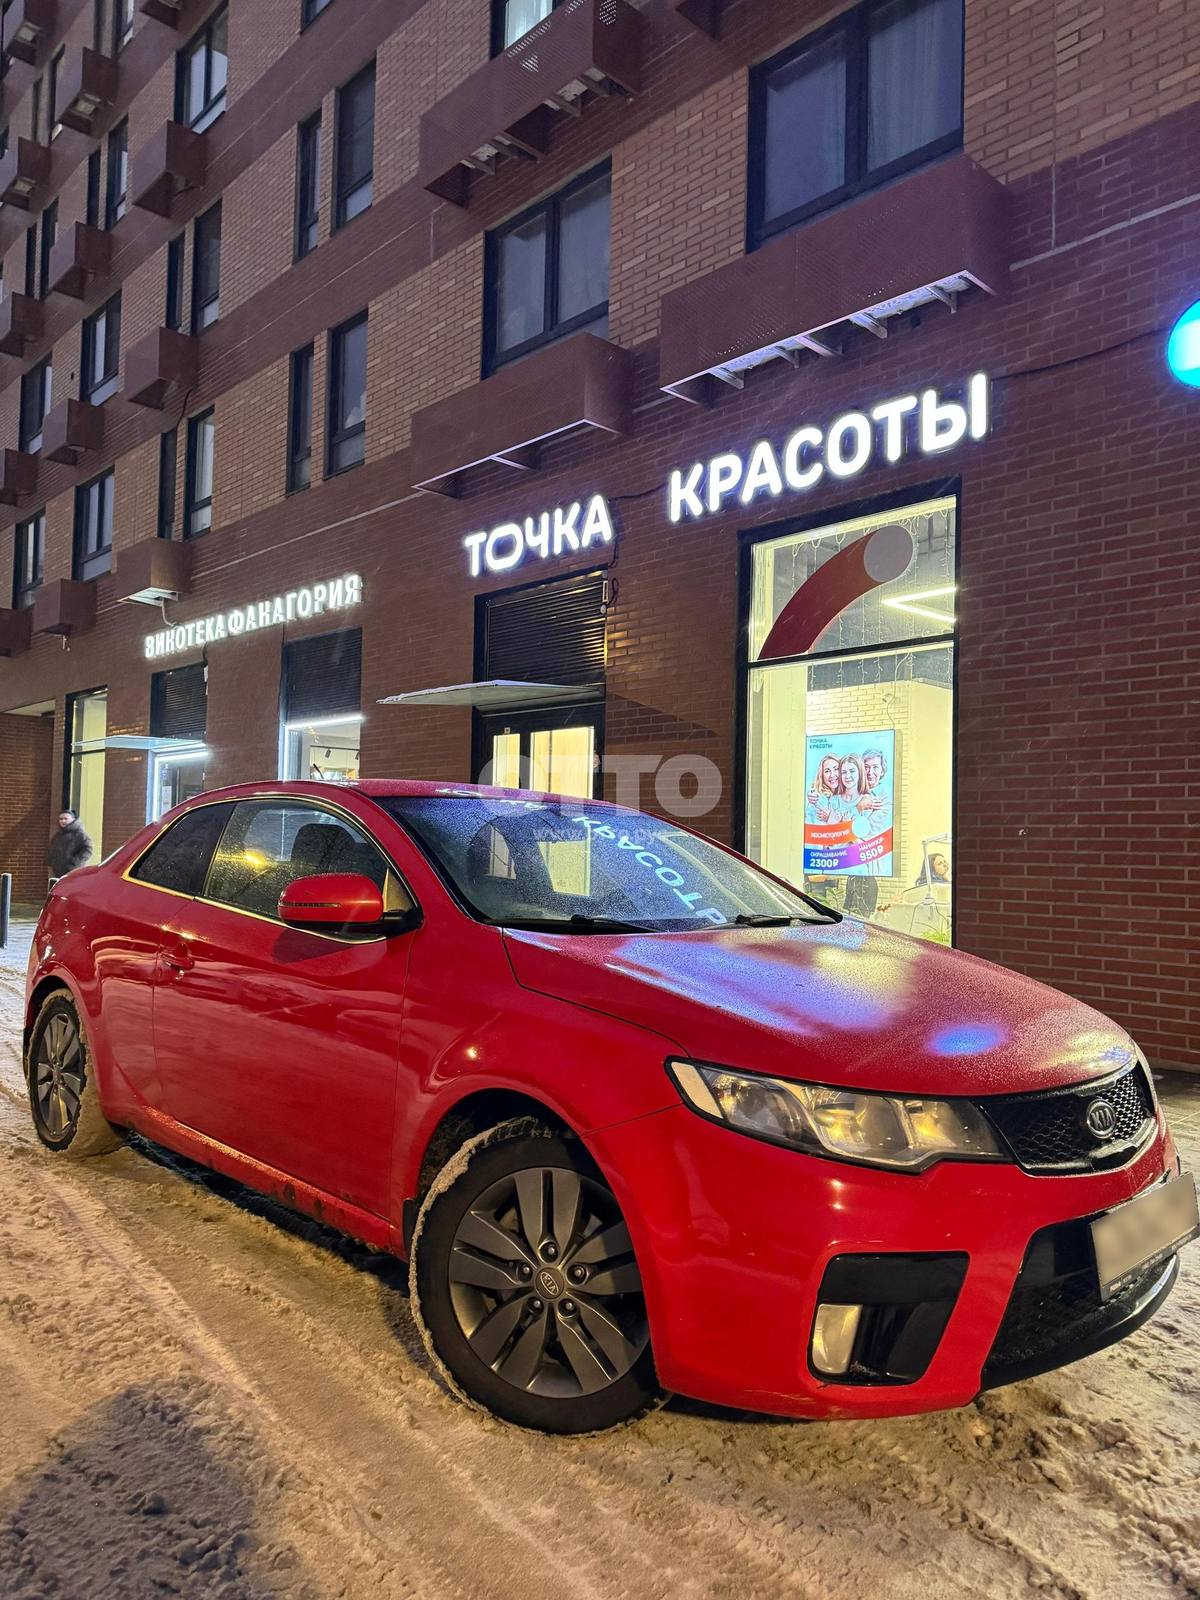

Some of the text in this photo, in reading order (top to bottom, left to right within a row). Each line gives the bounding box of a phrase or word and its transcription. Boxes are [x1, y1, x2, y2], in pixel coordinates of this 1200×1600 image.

[463, 373, 989, 577] ТОЧКА КРАСОТЫ
[144, 574, 363, 659] ВИНОТЕКА ФАНАГОРИЯ
[810, 850, 848, 859] ОКРАШИВАНИЕ
[1093, 1108, 1113, 1128] KIA
